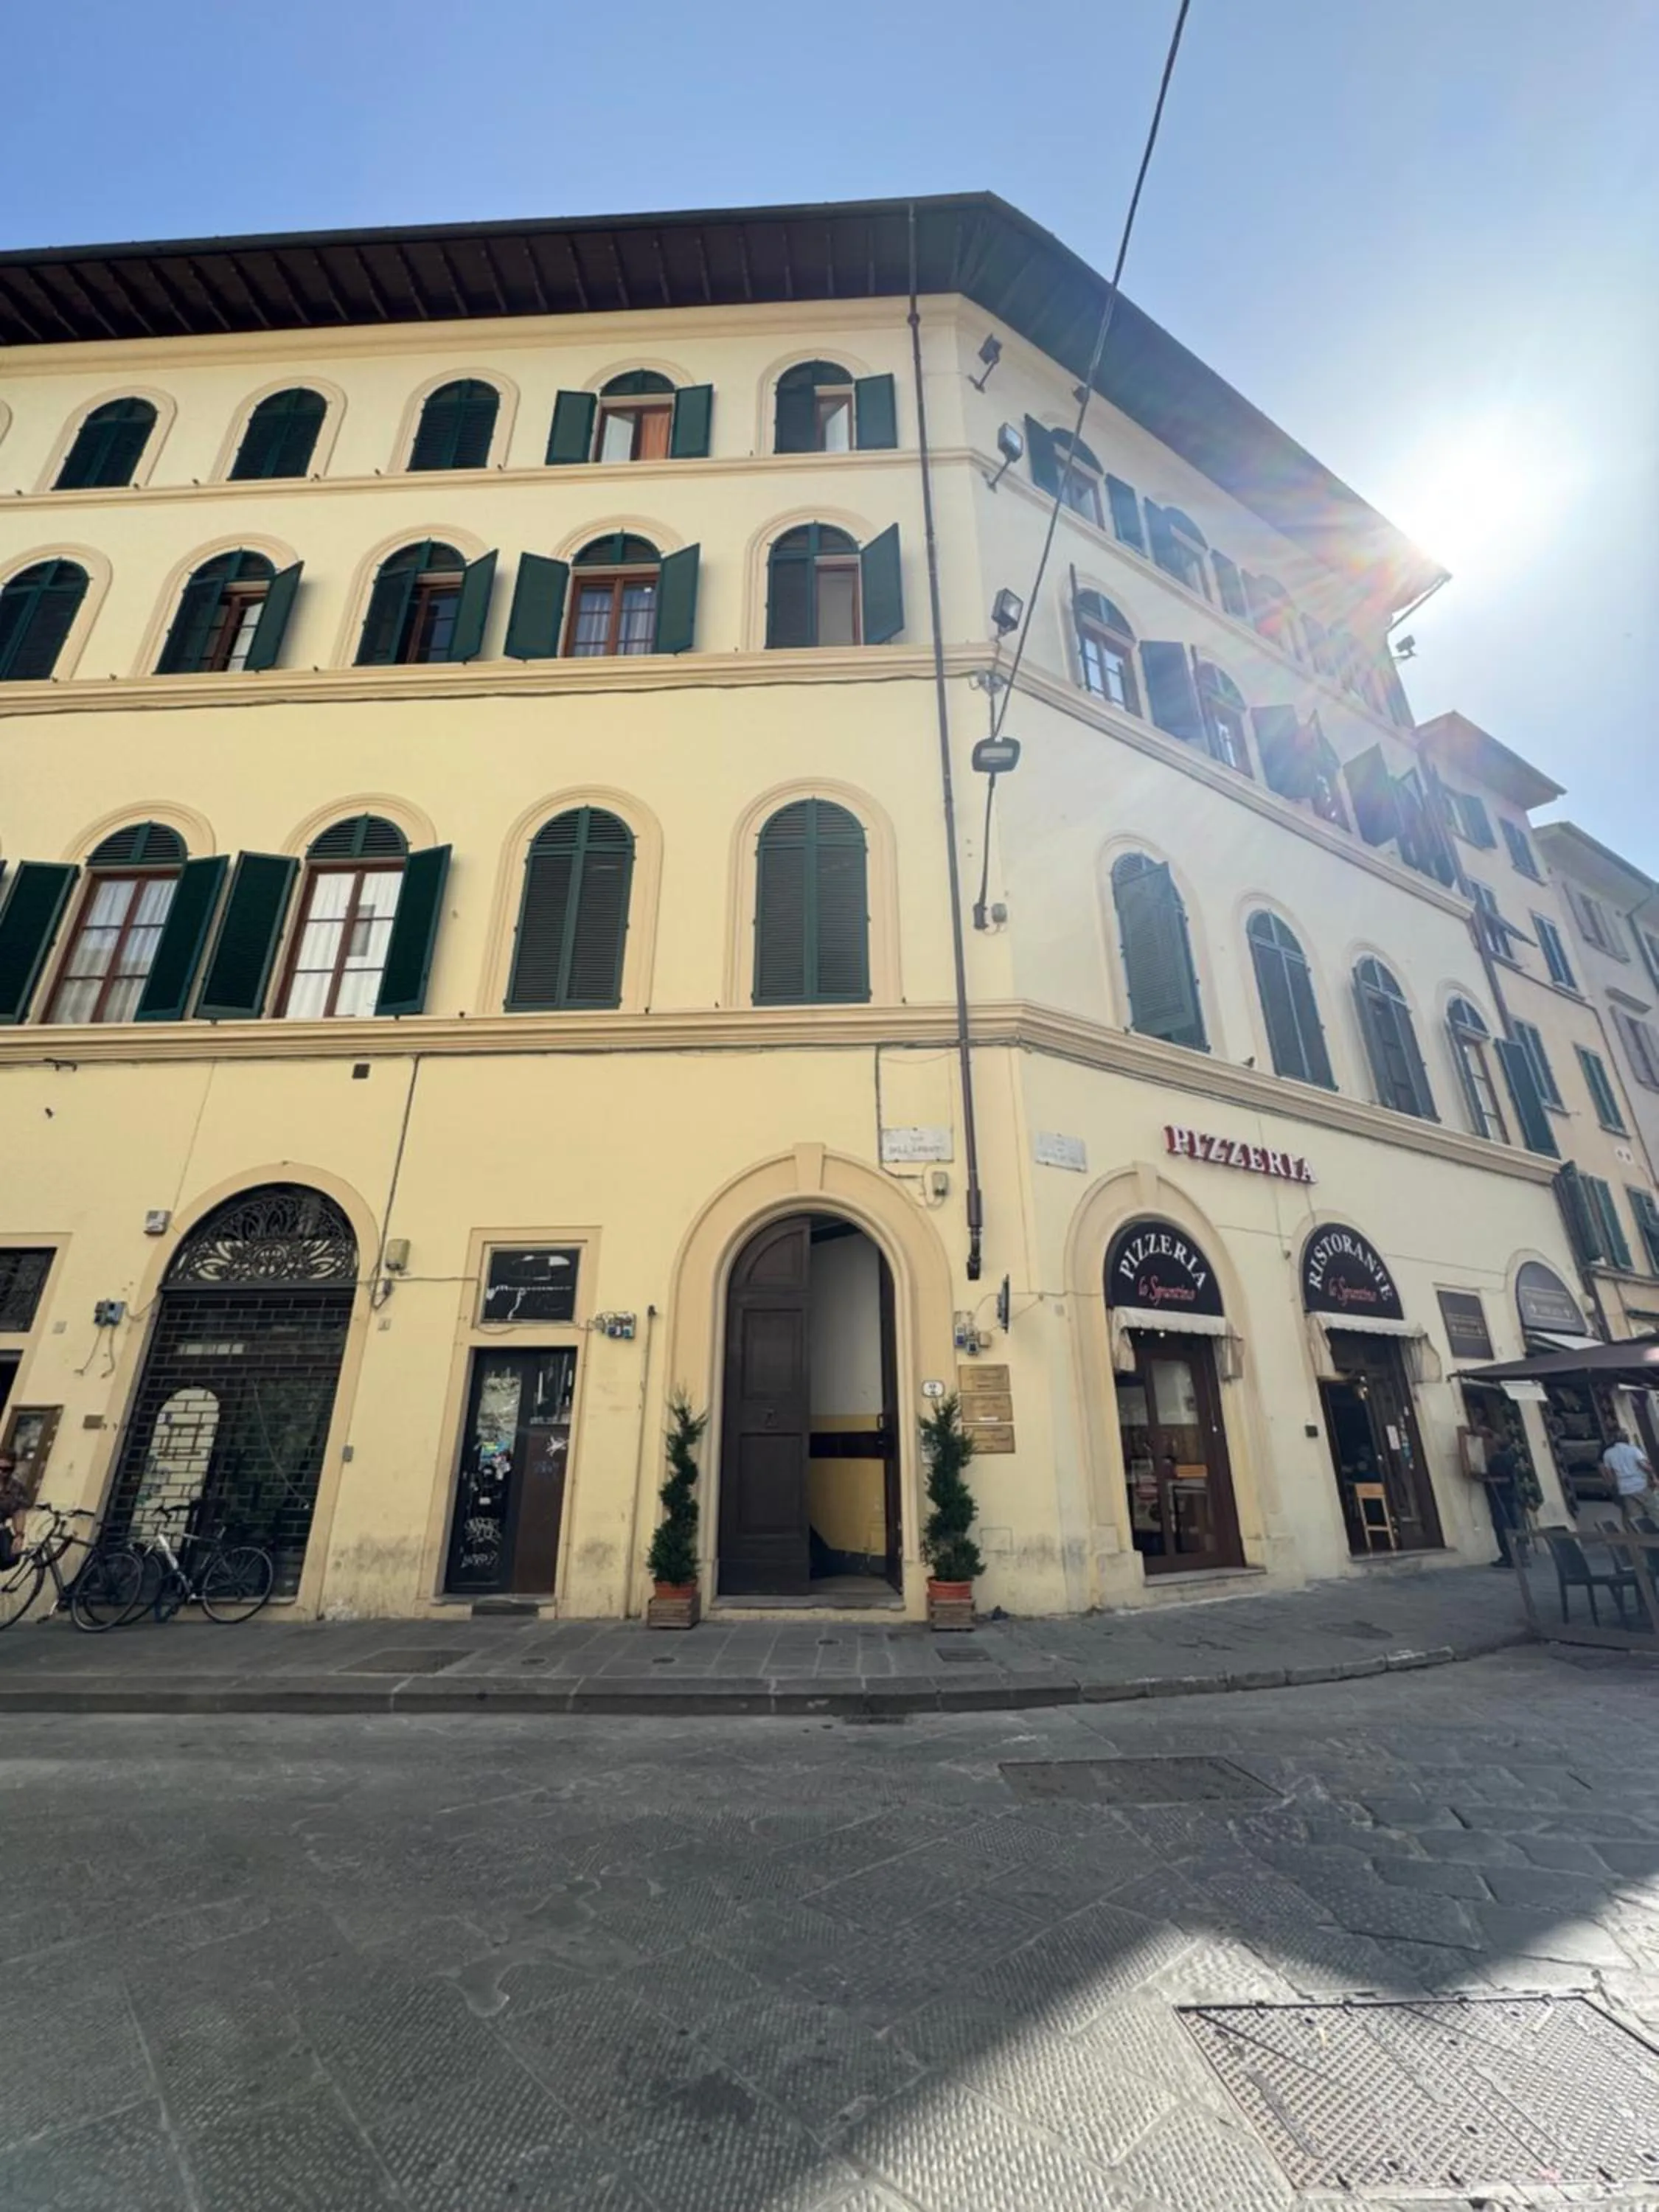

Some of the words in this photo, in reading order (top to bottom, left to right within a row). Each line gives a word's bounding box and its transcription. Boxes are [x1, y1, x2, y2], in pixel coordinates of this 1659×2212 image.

[1164, 1124, 1318, 1183] PIZZERIA
[1119, 1232, 1206, 1290] PIZZERIA
[1308, 1232, 1394, 1301] RISTORANTE
